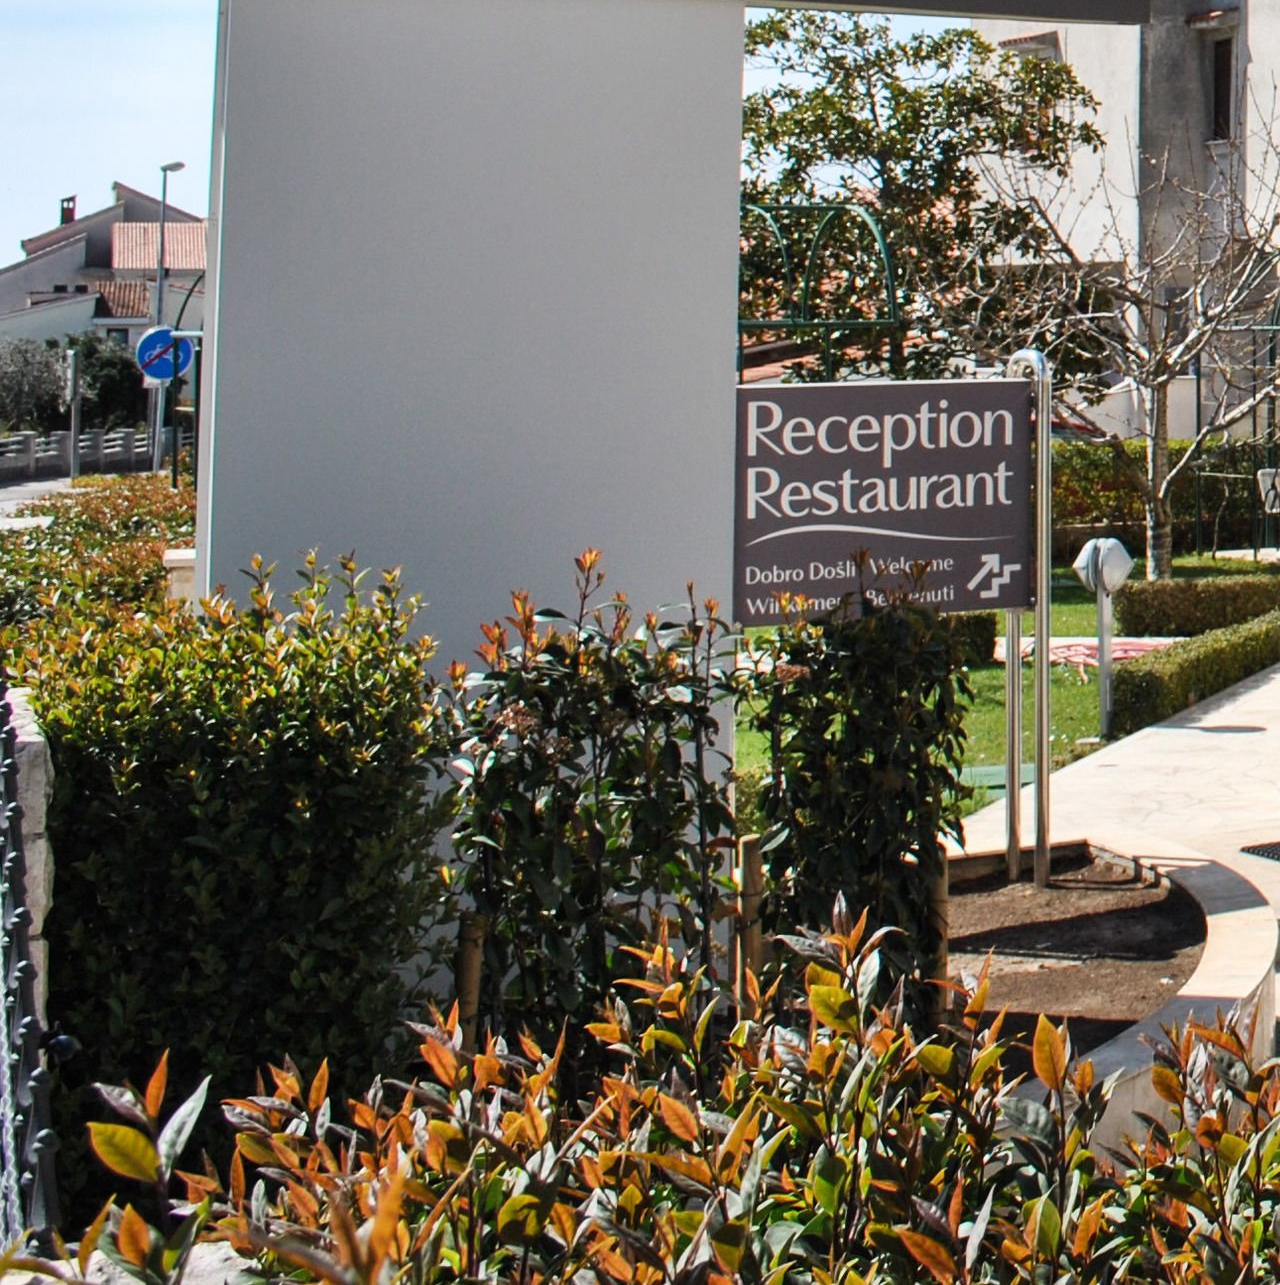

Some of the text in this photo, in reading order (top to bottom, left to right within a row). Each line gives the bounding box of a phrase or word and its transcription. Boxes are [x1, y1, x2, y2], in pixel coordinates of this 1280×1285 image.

[747, 399, 1013, 468] Reception
[747, 461, 1014, 519] Restaurant
[745, 559, 856, 585] Dobro Došli
[869, 556, 954, 575] Welcme
